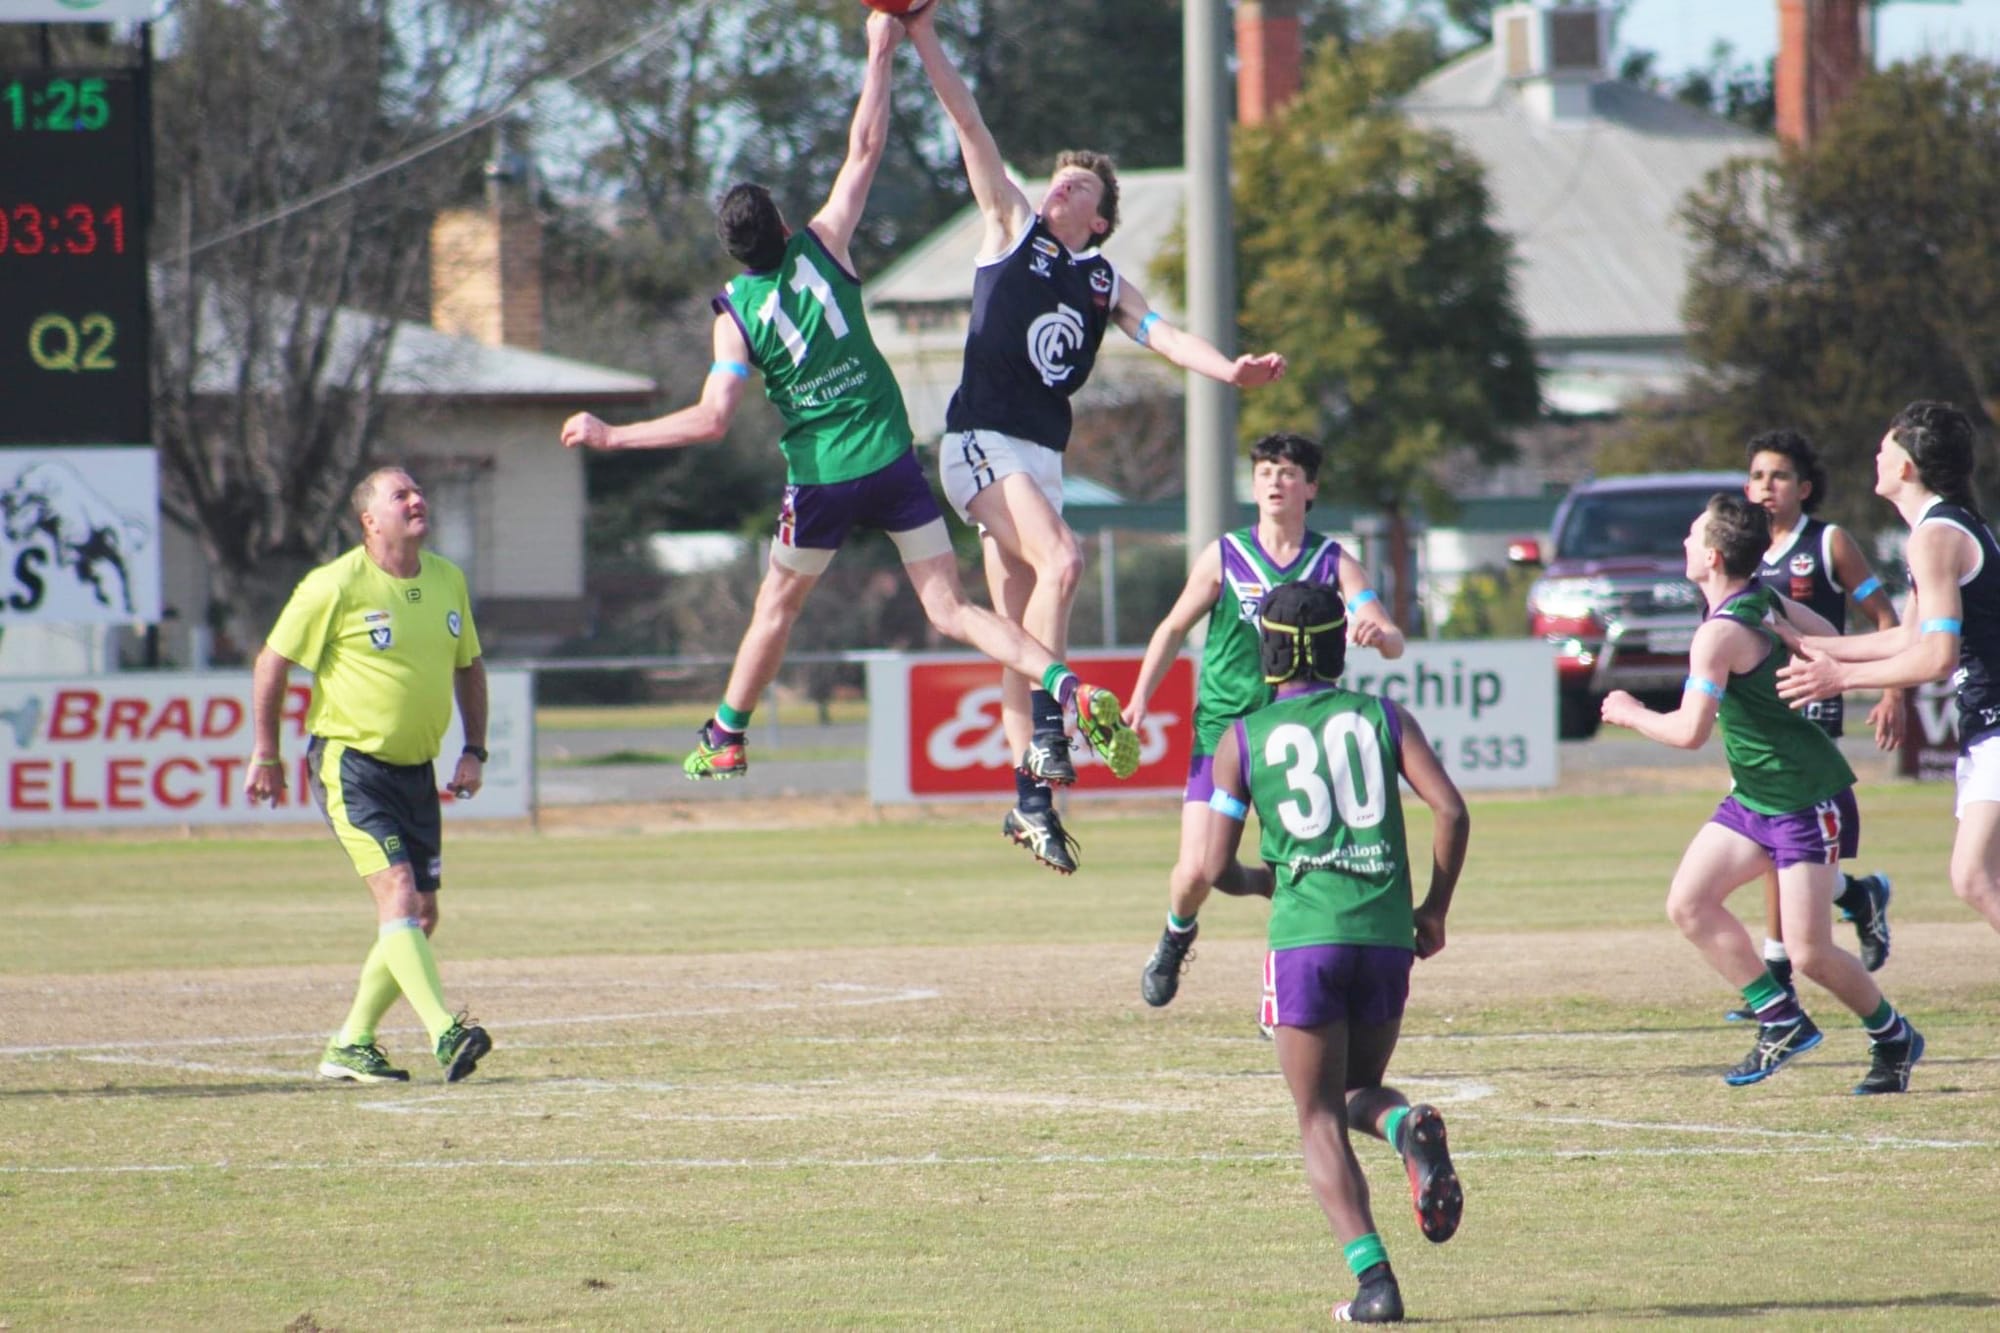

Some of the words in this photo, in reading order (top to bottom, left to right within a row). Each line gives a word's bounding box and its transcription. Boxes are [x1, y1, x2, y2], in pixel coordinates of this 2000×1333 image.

[757, 253, 849, 368] 11
[29, 314, 116, 372] Q2
[47, 690, 244, 742] BRAD
[1264, 711, 1386, 840] 30
[1461, 734, 1527, 771] 533
